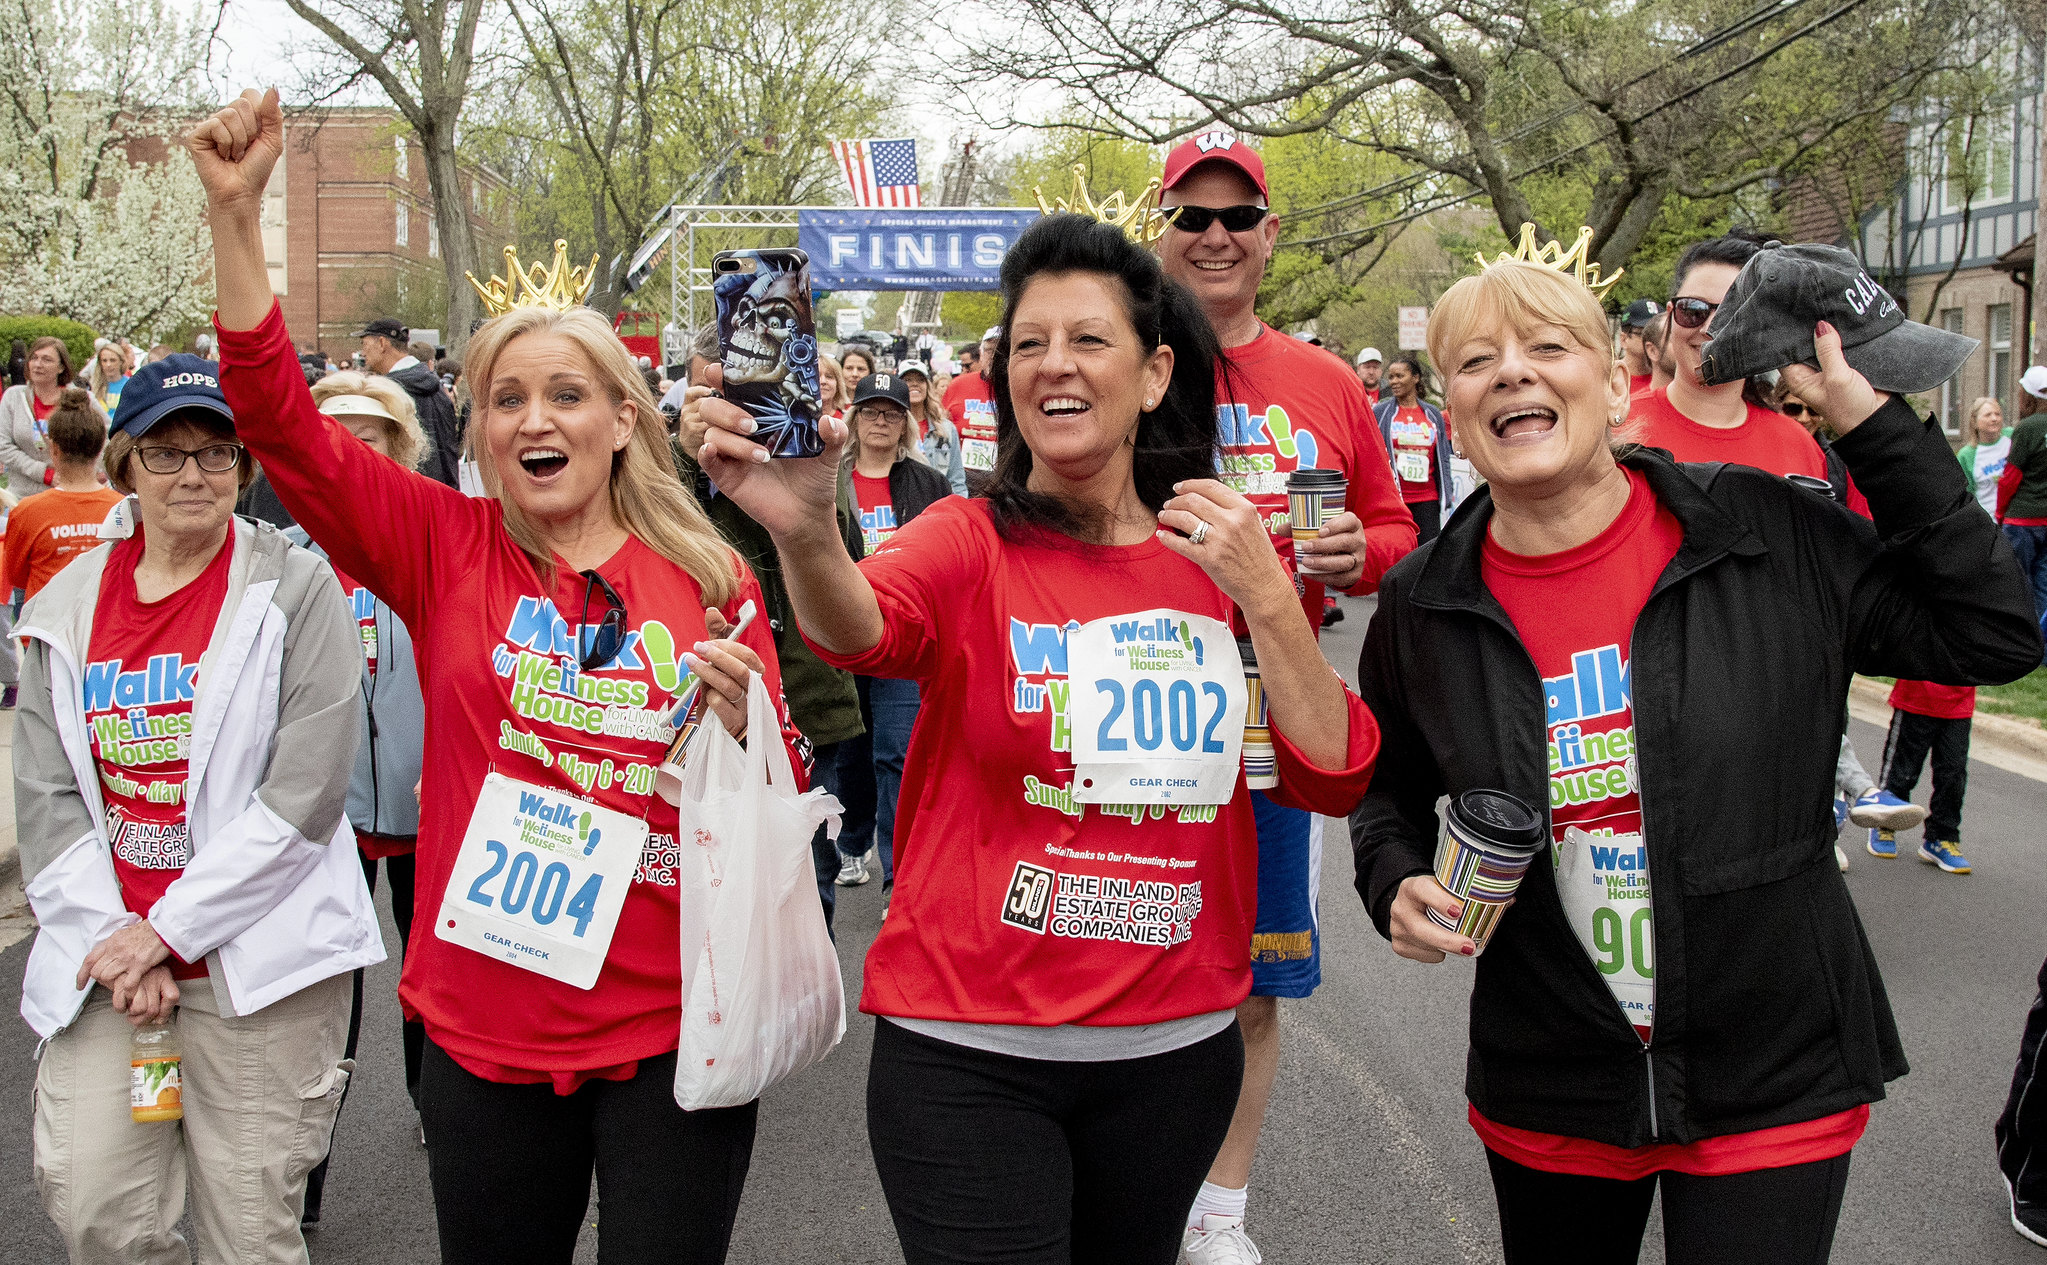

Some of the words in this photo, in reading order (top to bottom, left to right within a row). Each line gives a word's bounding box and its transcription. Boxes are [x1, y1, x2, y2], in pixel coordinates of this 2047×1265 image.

[1195, 131, 1237, 154] W
[829, 233, 1007, 269] FINIS
[162, 372, 218, 389] HOPE
[1216, 404, 1270, 445] lk
[965, 452, 991, 468] 1364
[1402, 465, 1425, 479] 1812
[859, 505, 898, 529] alk
[50, 523, 103, 539] VOLUNT
[1110, 618, 1180, 643] Walk
[492, 644, 517, 677] for
[1114, 647, 1125, 656] for
[1130, 658, 1170, 671] House
[85, 653, 199, 712] Walk
[1015, 679, 1044, 709] for
[1543, 644, 1631, 728] alk
[512, 683, 603, 732] House
[607, 708, 625, 721] for
[628, 712, 660, 725] LIVIN
[1095, 678, 1227, 753] 2002
[94, 708, 192, 742] Wellnes
[604, 723, 634, 735] with
[102, 740, 179, 766] House
[558, 753, 600, 794] May
[600, 760, 614, 790] 6
[624, 764, 656, 796] 201
[1129, 778, 1163, 787] GEAR
[1166, 778, 1198, 788] CHECK
[1550, 765, 1628, 808] ouse
[147, 781, 181, 805] May
[1024, 776, 1085, 822] Sund
[1160, 790, 1172, 798] 2002
[512, 815, 523, 827] for
[518, 790, 579, 829] Walk
[520, 831, 556, 852] House
[645, 834, 678, 849] EAL
[1066, 848, 1095, 860] Thanks
[1096, 851, 1105, 861] to
[1107, 851, 1123, 862] Our
[1123, 853, 1168, 868] Presenting
[1168, 857, 1197, 870] Sponsor
[1590, 845, 1646, 871] Wal
[466, 839, 604, 938] 2004
[1058, 874, 1099, 896] THE
[1102, 879, 1176, 903] INLAND
[1180, 880, 1202, 902] REAL
[1592, 873, 1602, 885] for
[1605, 873, 1649, 887] Welln
[1010, 868, 1050, 919] 50
[1607, 887, 1650, 900] House
[1008, 912, 1039, 927] YEARS
[1055, 896, 1129, 919] ESTATE
[1132, 902, 1188, 923] GROUP
[1188, 900, 1202, 918] OF
[484, 932, 511, 948] GEAR
[513, 942, 550, 960] CHECK
[1052, 918, 1173, 949] COMPANIES,
[1592, 907, 1653, 979] 90
[506, 951, 517, 960] 2004
[1621, 1000, 1644, 1011] EAR
